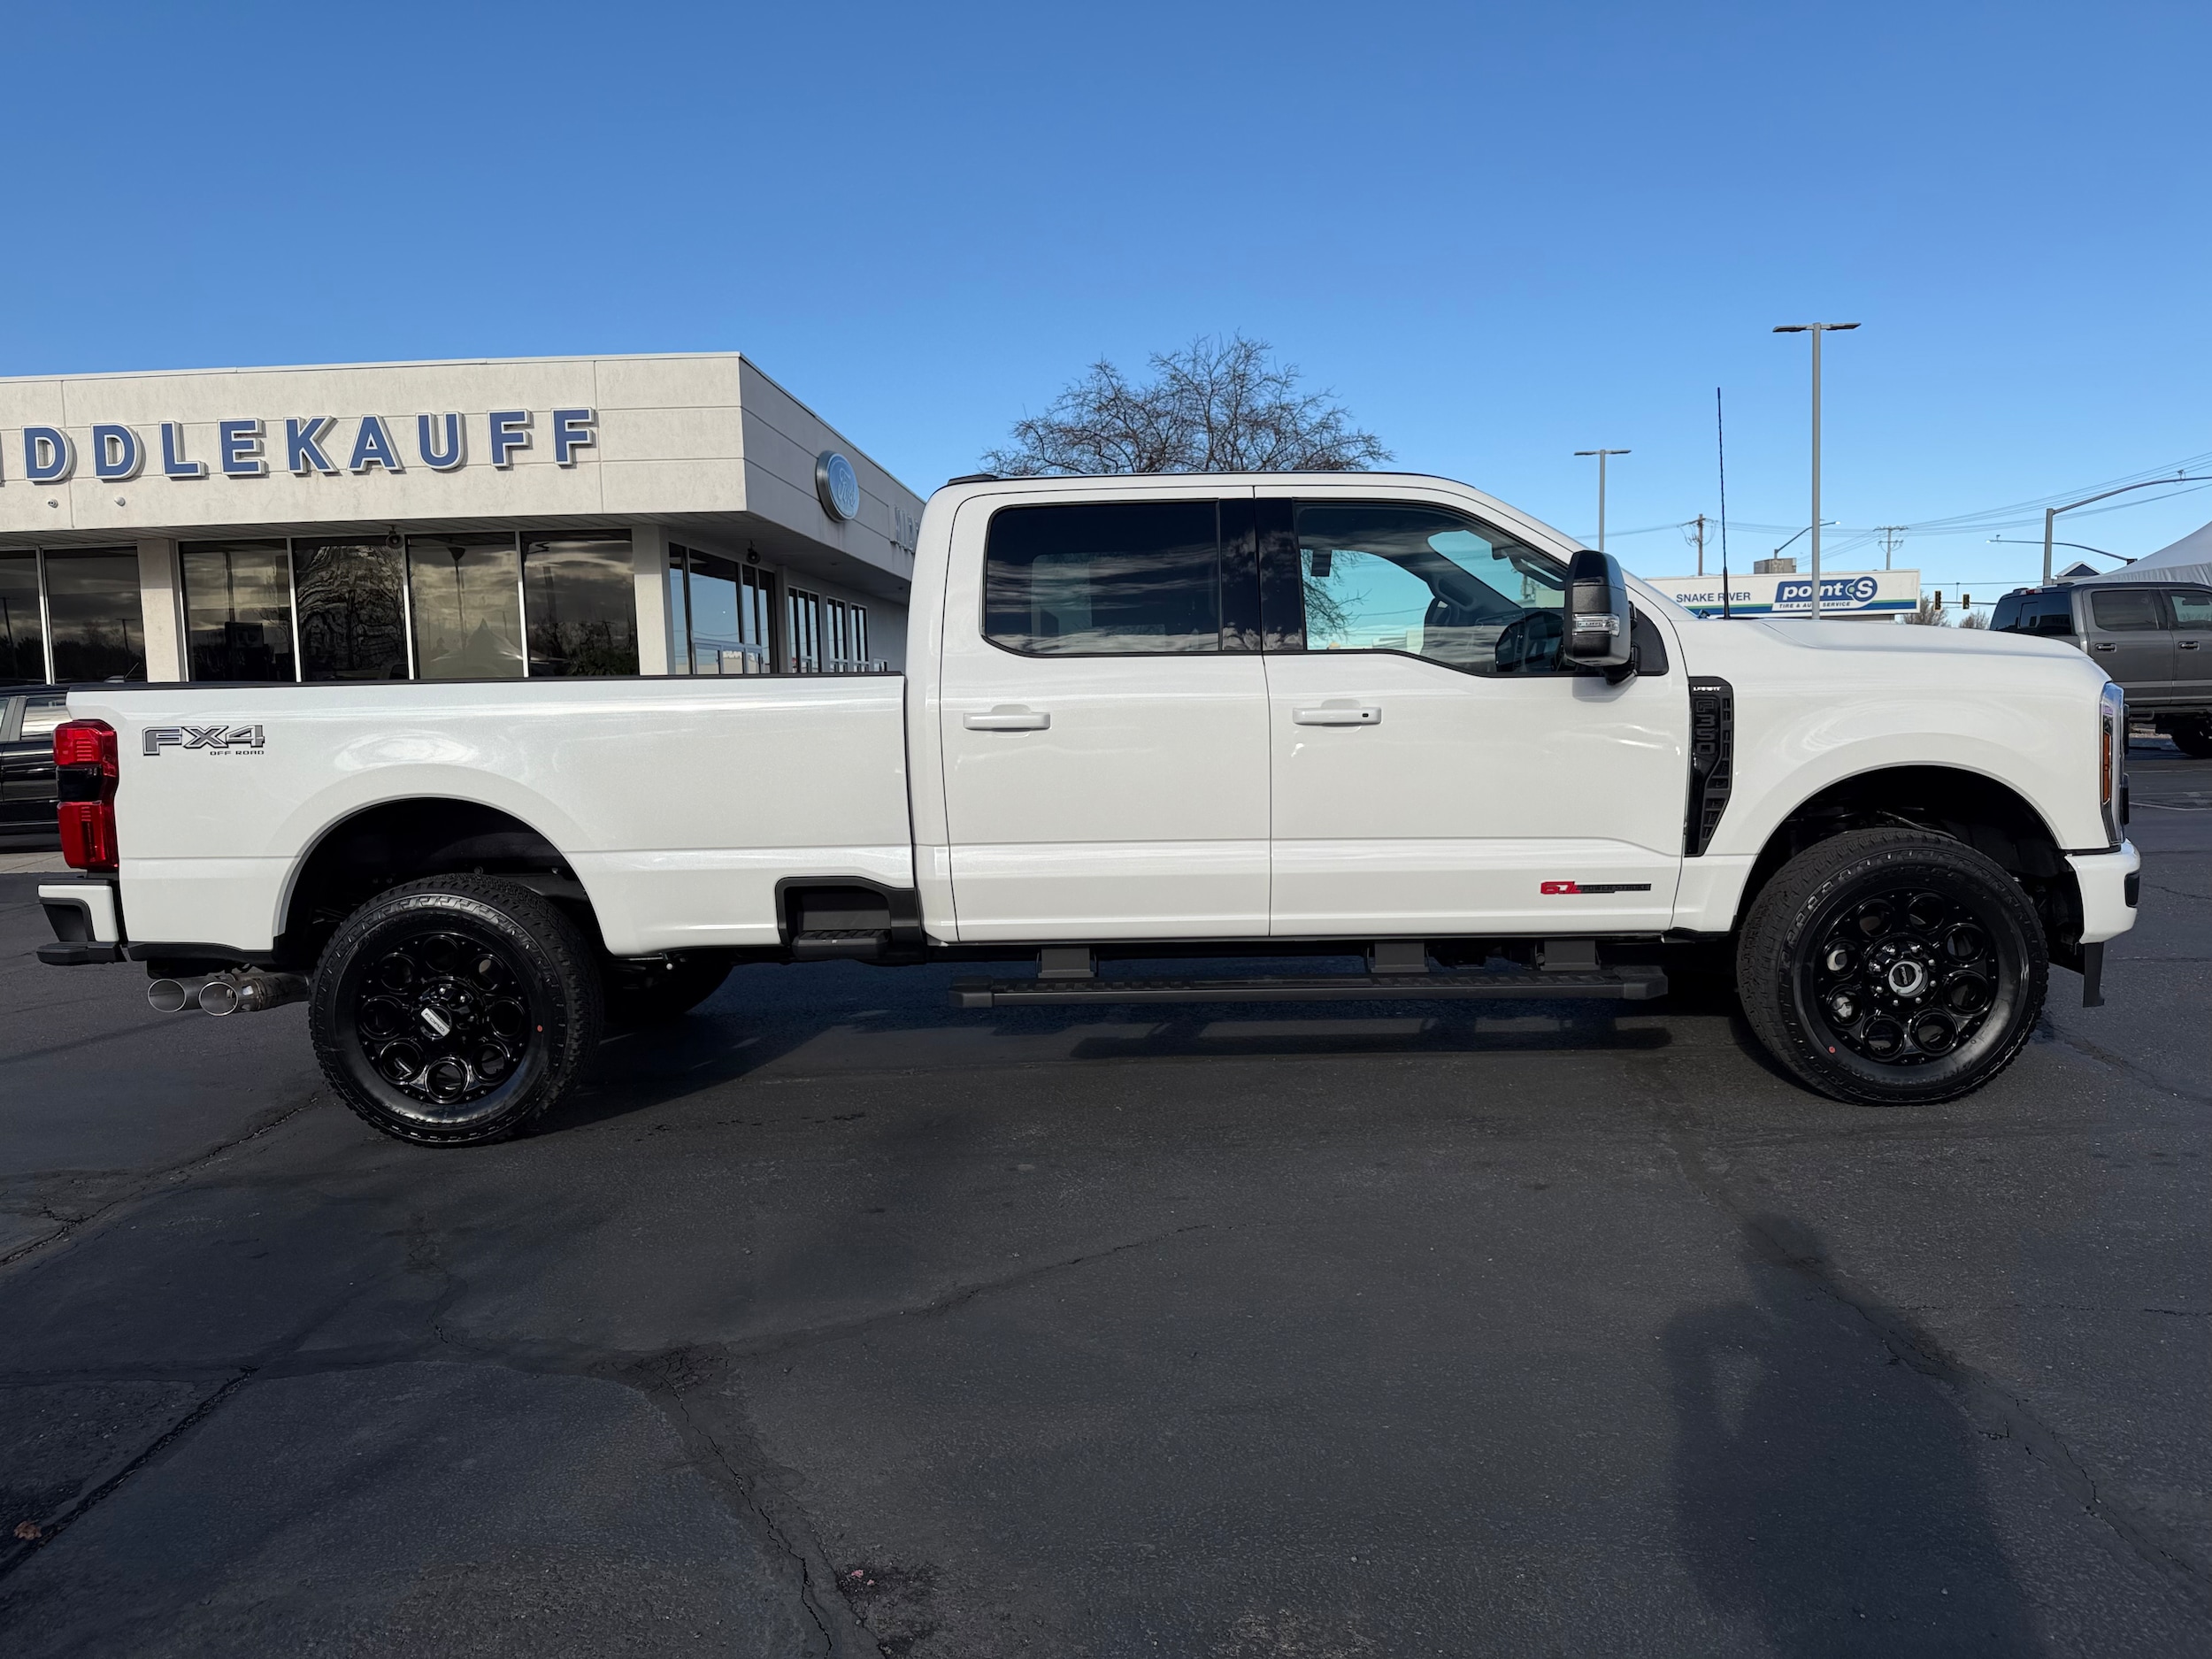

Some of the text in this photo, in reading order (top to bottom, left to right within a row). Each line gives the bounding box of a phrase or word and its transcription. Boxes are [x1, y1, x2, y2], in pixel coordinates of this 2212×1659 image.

[0, 407, 595, 484] DDLEKAUFF
[1676, 591, 1751, 603] SNAKE RVER
[1782, 582, 1844, 601] pont
[142, 725, 265, 757] FX4
[425, 1012, 446, 1033] FORD
